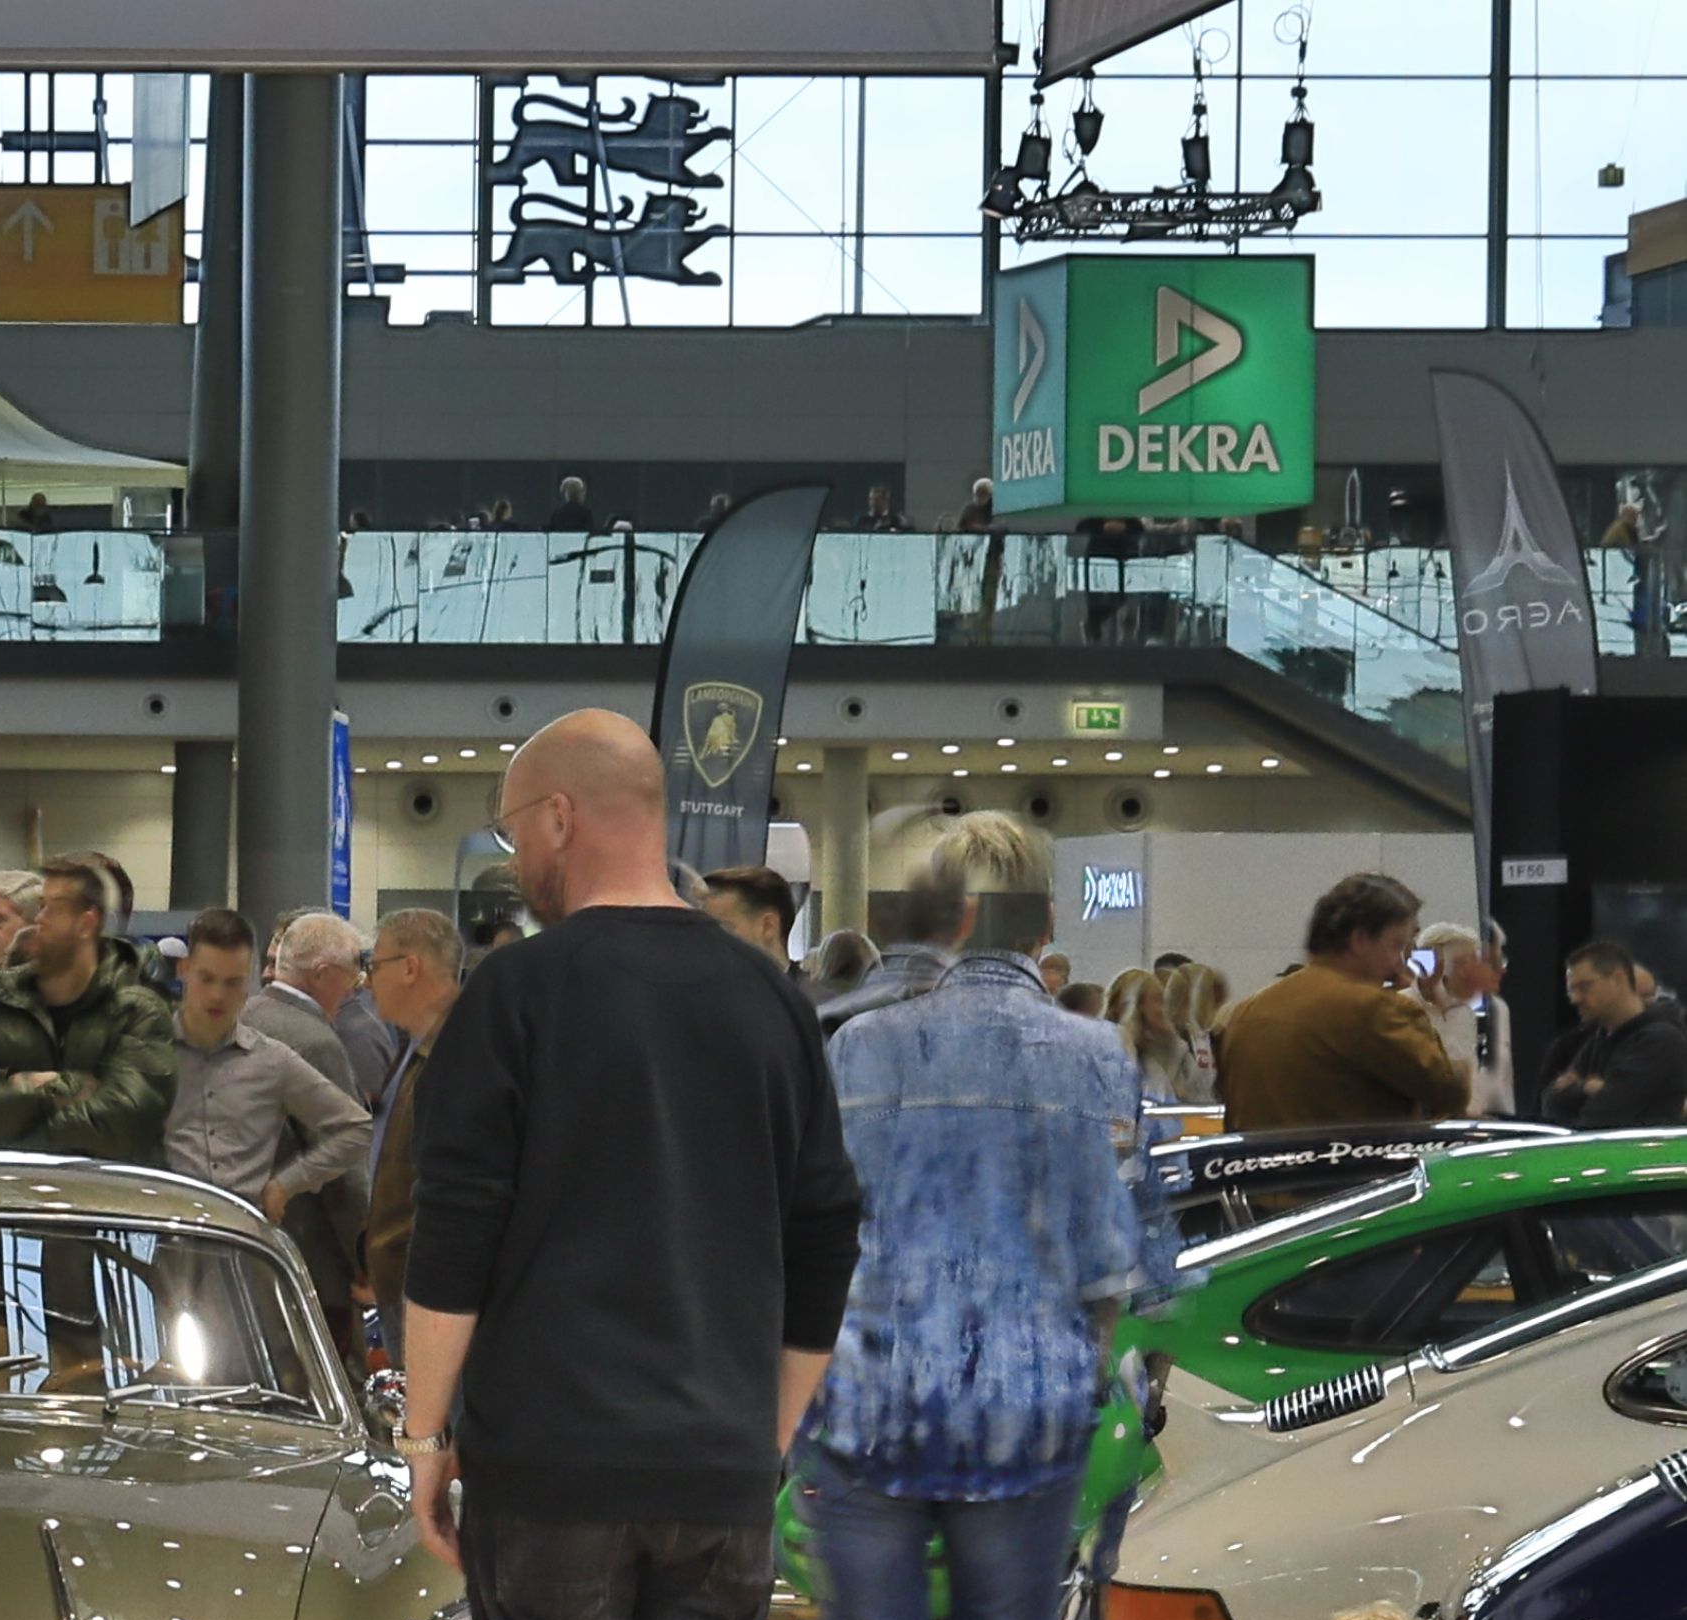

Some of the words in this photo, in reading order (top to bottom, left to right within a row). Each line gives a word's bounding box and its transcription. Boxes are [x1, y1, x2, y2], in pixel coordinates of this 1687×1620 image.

[1001, 427, 1056, 482] DEKRA
[1099, 424, 1281, 473] DEKRA
[680, 800, 744, 817] STUTTGART
[1508, 864, 1545, 878] 1F50
